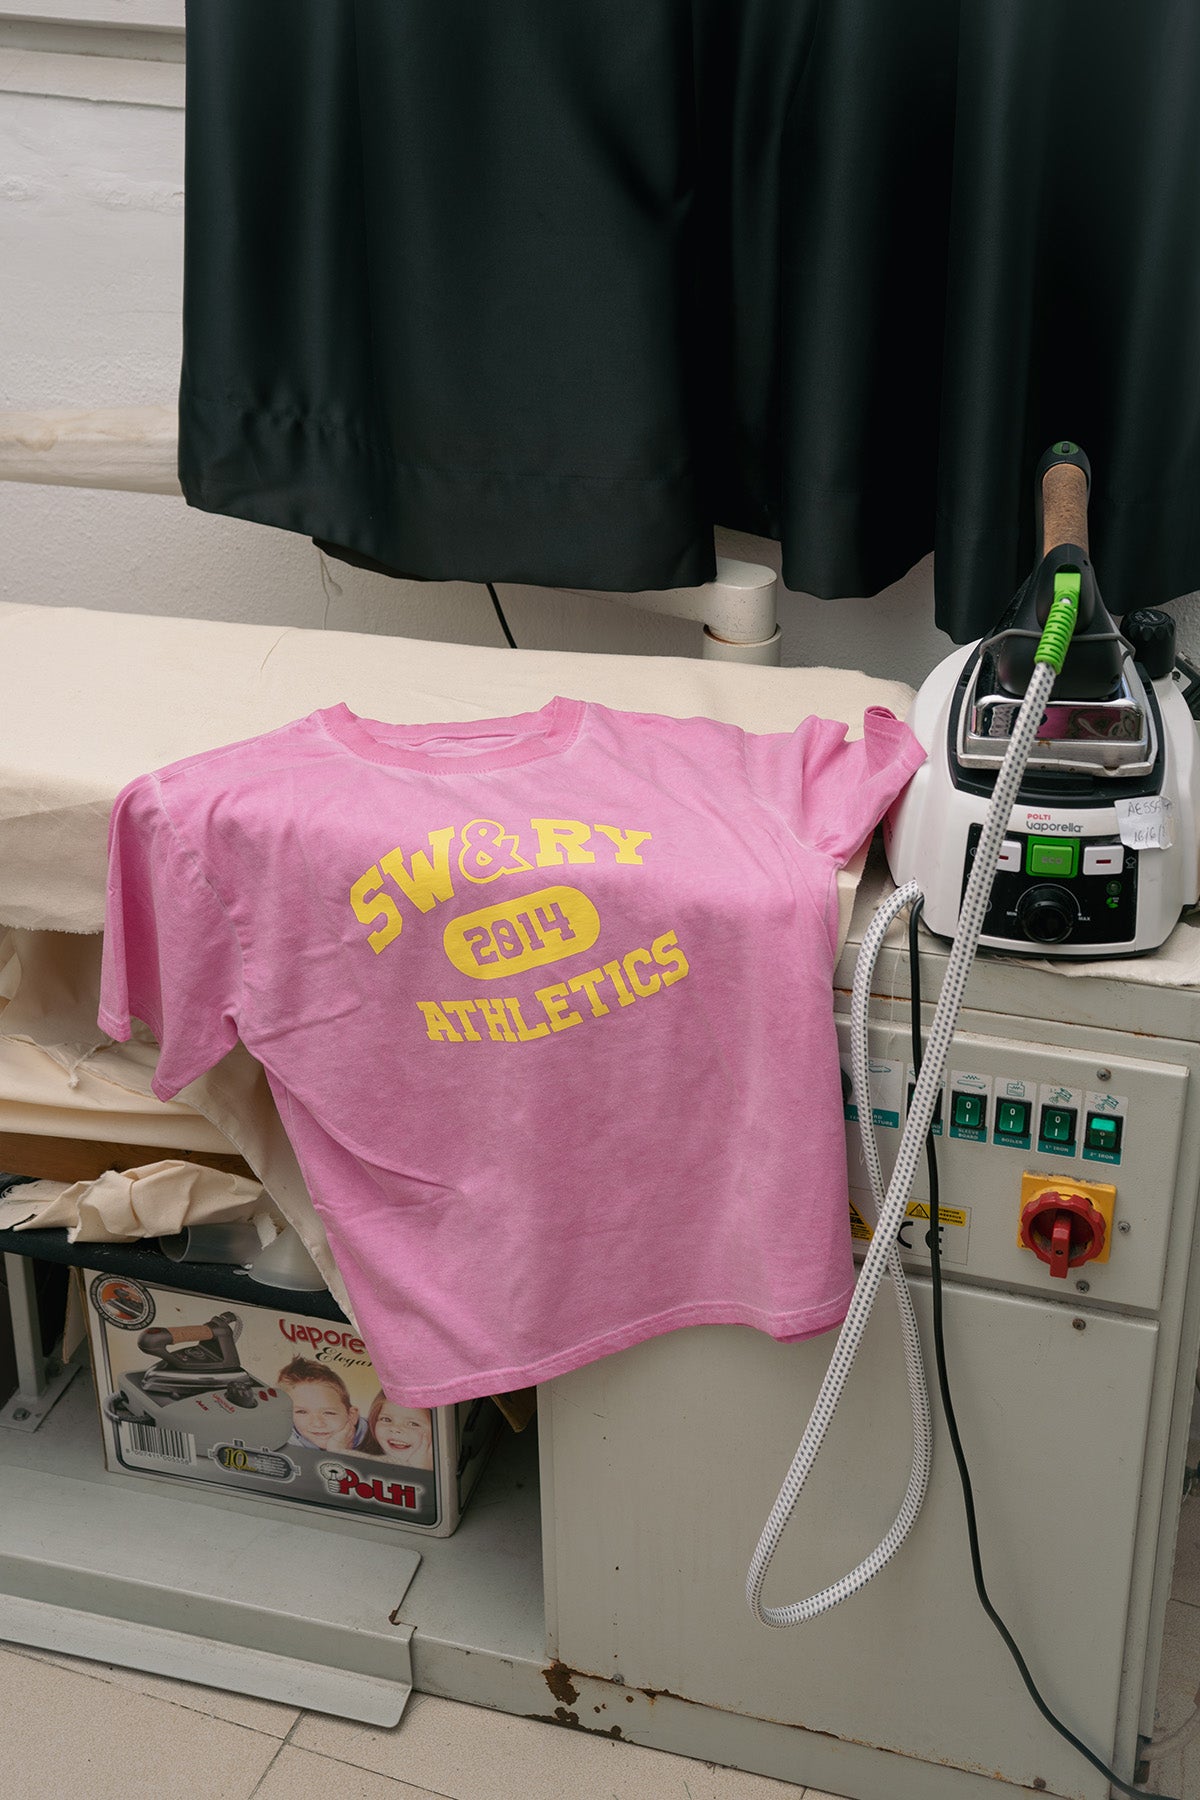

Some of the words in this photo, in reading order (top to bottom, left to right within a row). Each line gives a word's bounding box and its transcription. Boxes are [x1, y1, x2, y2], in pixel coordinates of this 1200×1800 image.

[350, 818, 652, 955] SW&RY
[462, 902, 577, 966] 2014
[415, 929, 690, 1042] ATHLETICS
[279, 1319, 366, 1354] Vapore
[223, 1448, 249, 1470] 10
